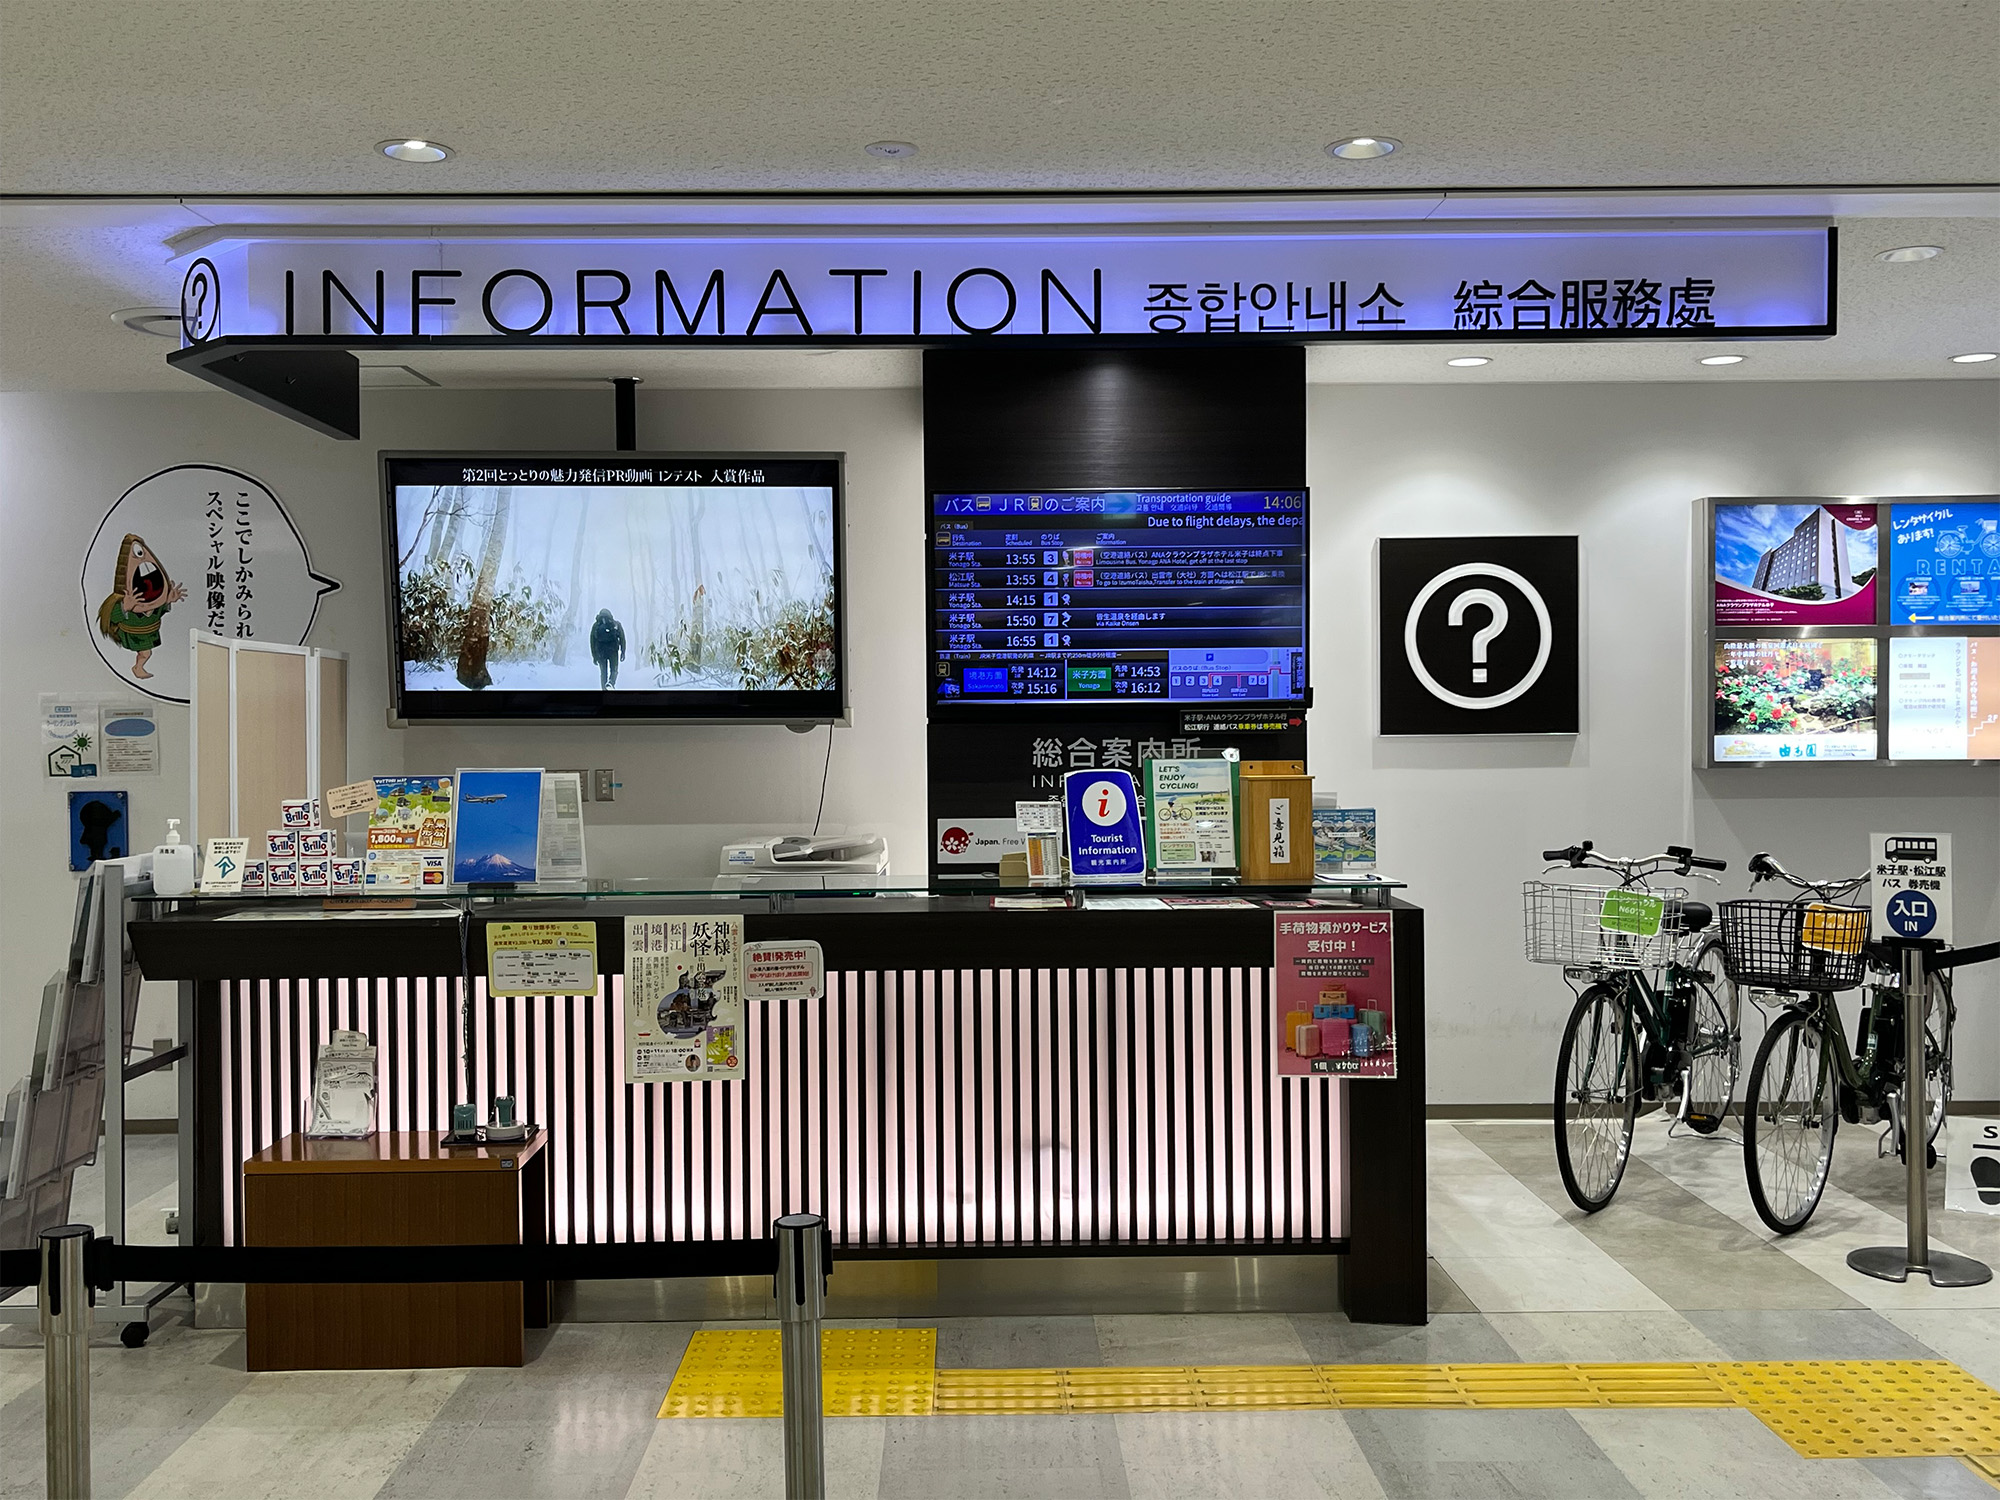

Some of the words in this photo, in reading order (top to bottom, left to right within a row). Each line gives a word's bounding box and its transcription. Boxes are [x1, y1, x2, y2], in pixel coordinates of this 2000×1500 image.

[285, 268, 1102, 336] INFORMATION
[1143, 280, 1406, 334] 종합안내소
[1452, 276, 1717, 330] 綜合服務處
[710, 469, 765, 483] 入賞作品
[944, 497, 974, 512] バス
[1044, 496, 1105, 512] のご案内
[1136, 493, 1203, 505] Transportation
[1205, 493, 1231, 505] guide
[1263, 495, 1302, 510] 14:06
[1148, 516, 1169, 527] Due
[1172, 516, 1183, 527] to
[1185, 515, 1214, 529] flight
[1217, 515, 1255, 529] delays,
[1257, 515, 1275, 526] the
[1893, 508, 1953, 531] レンタサイクル
[1040, 533, 1060, 541] のりば
[1096, 532, 1114, 540] ご案内
[949, 551, 975, 561] 米子駅
[1006, 553, 1036, 565] 13:55
[949, 572, 975, 581] 松江駅
[1006, 574, 1036, 585] 13:55
[949, 593, 975, 602] 米子駅
[1006, 595, 1036, 606] 14:15
[949, 613, 975, 623] 米子駅
[1006, 615, 1036, 626] 15:50
[949, 634, 975, 643] 米子駅
[1006, 636, 1036, 647] 16:55
[1027, 667, 1057, 678] 14:12
[1131, 666, 1161, 677] 14:53
[1027, 683, 1057, 694] 15:16
[1078, 682, 1100, 690] Yonago
[1131, 682, 1161, 694] 16:12
[1987, 714, 1999, 722] 2F
[1032, 737, 1202, 768] 総合案内所
[1158, 765, 1180, 773] LET'S
[1159, 782, 1199, 790] CYCLING!
[285, 811, 309, 823] Brillo
[1272, 804, 1285, 858] ご意見箱
[371, 834, 402, 844] 1,800円
[975, 837, 1000, 847] Japan.
[1002, 837, 1019, 846] Free
[1091, 834, 1123, 843] Tourist
[270, 841, 295, 853] Brillo
[302, 841, 327, 852] Brillo
[1078, 846, 1137, 856] Information
[1091, 858, 1127, 867] 観光案内所
[1876, 864, 1947, 877] 米子駅・松江駅
[271, 871, 296, 883] Brillo
[302, 871, 327, 883] Brillo
[1882, 878, 1901, 888] バス
[1908, 879, 1941, 890] 券売機
[1893, 899, 1928, 918] 入口
[1279, 921, 1389, 935] 手荷物預かりサービス
[1904, 920, 1918, 932] IN
[632, 924, 644, 952] 出雲
[651, 923, 662, 951] 境港
[670, 923, 682, 951] 松江
[1983, 1125, 1998, 1139] S
